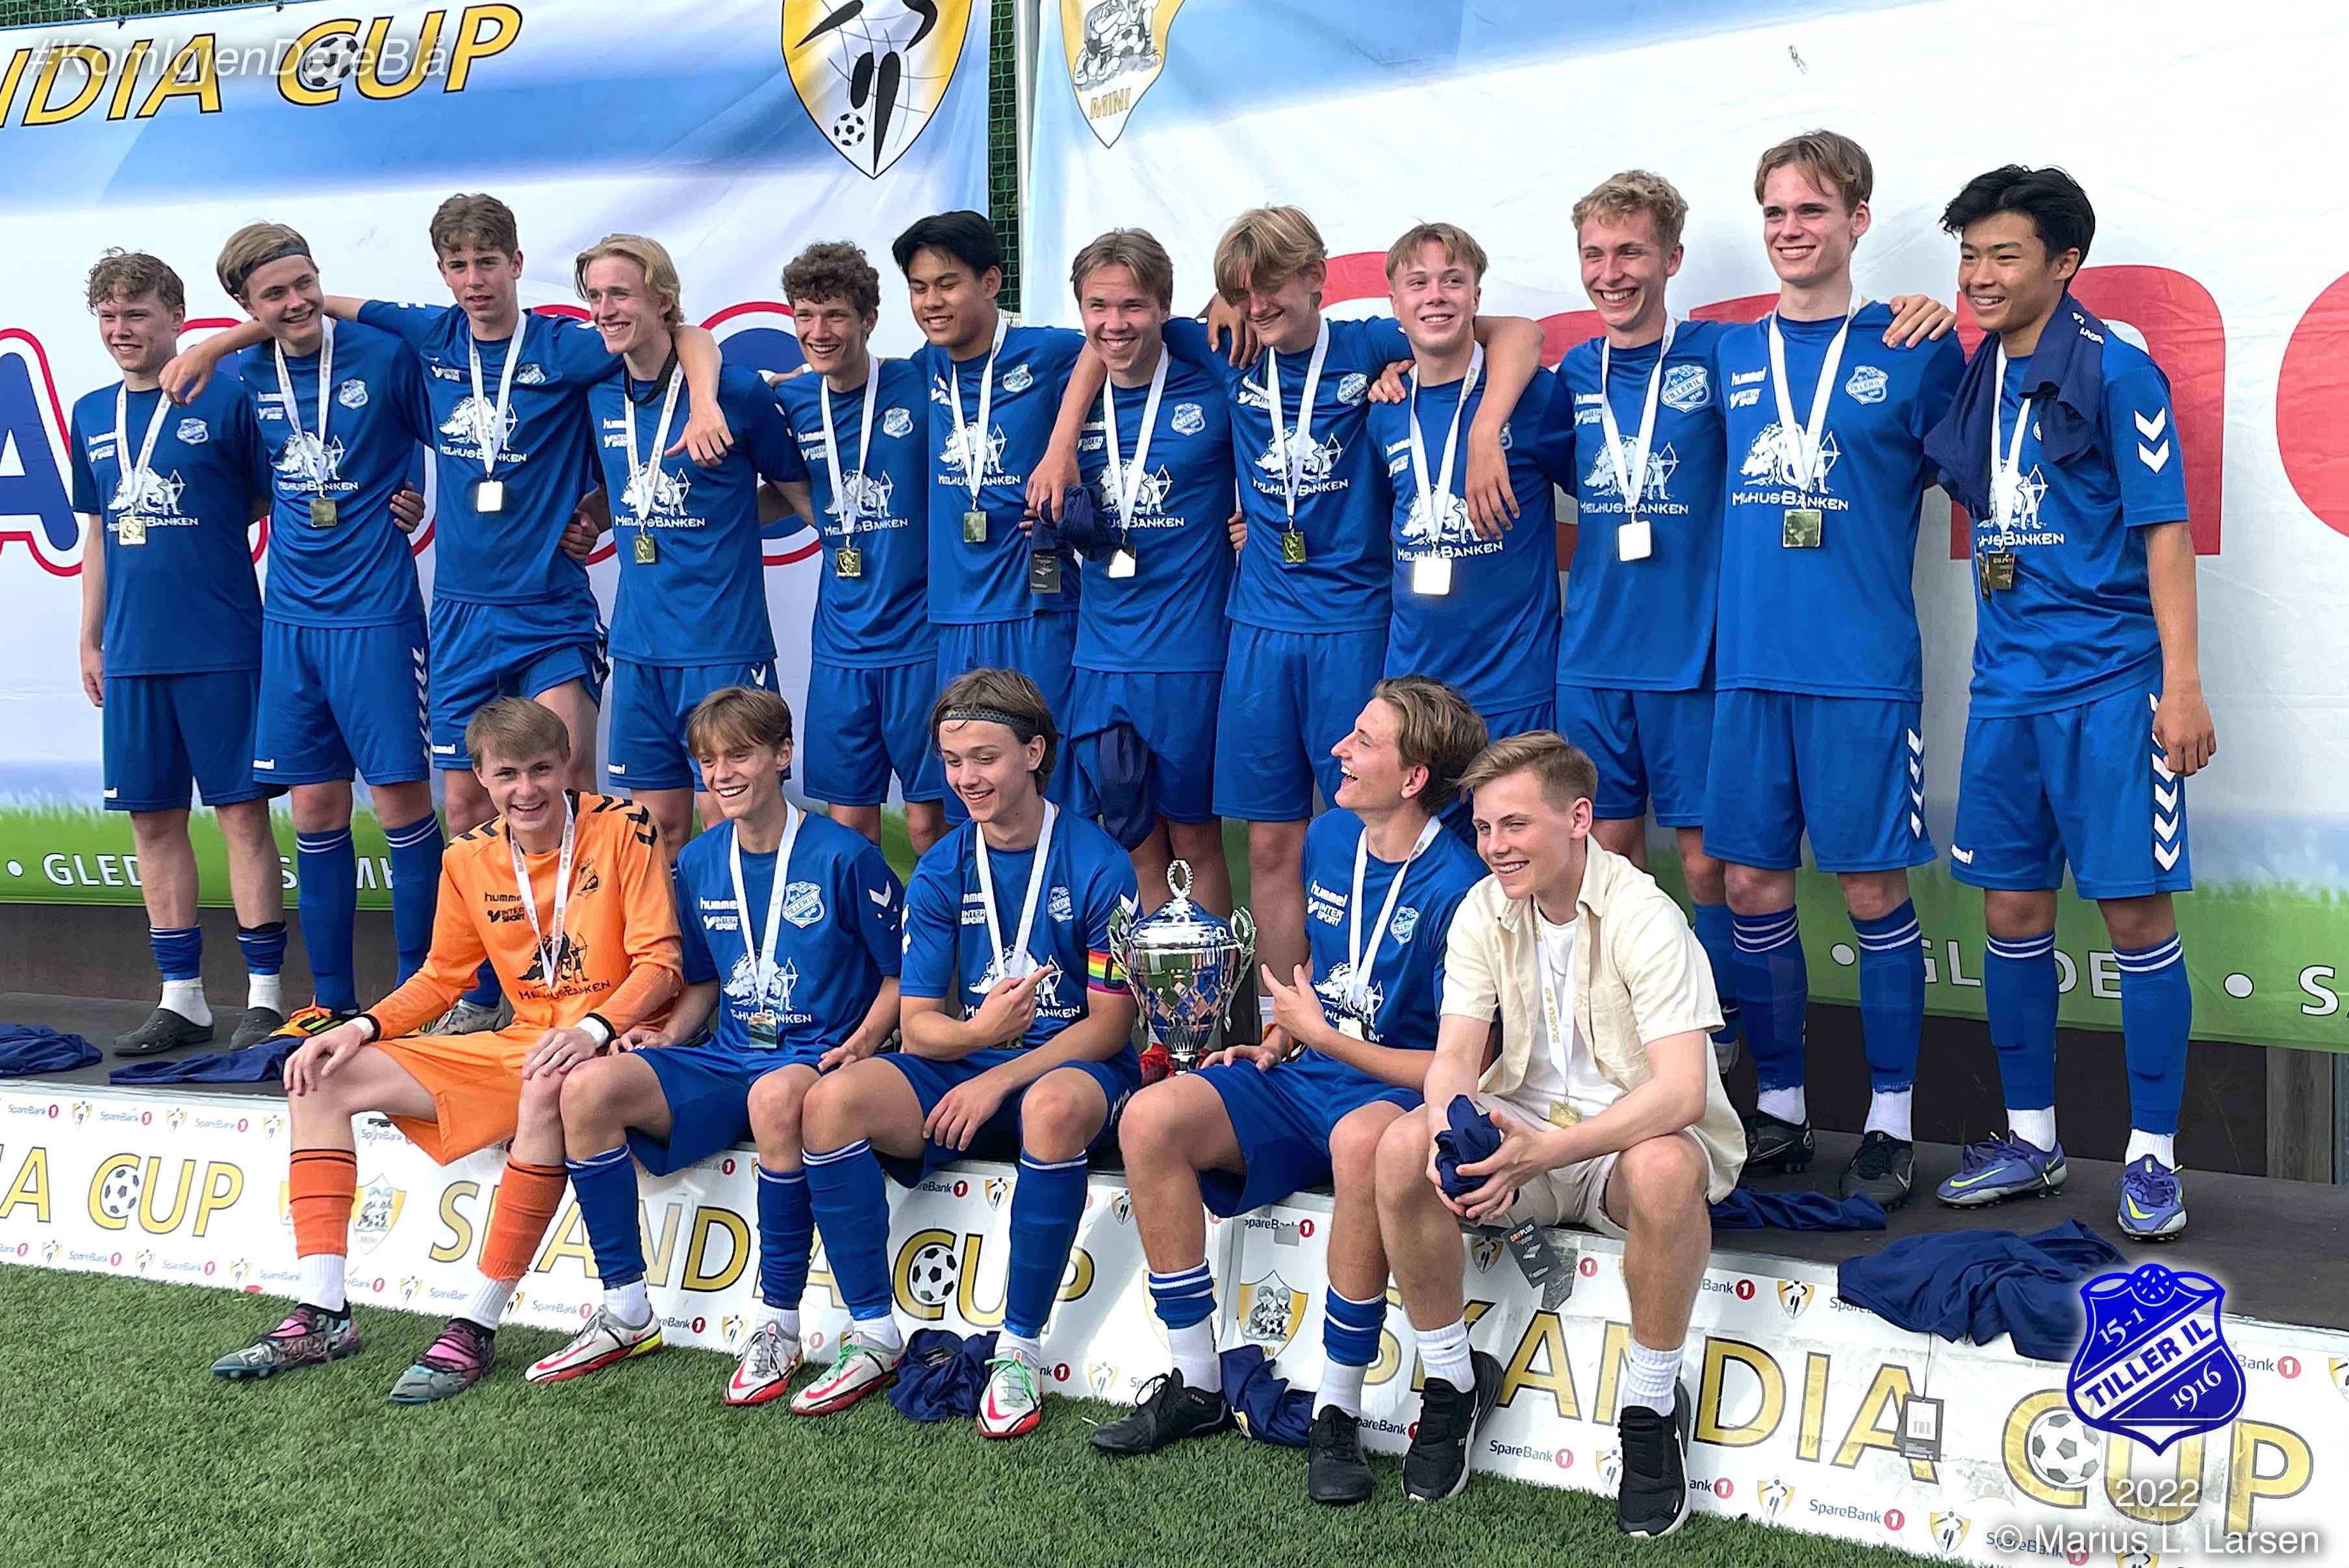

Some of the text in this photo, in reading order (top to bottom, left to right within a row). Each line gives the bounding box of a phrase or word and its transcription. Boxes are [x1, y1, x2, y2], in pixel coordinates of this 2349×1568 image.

[0, 3, 523, 127] DIA CUP
[1089, 88, 1131, 120] MINI
[43, 854, 141, 887] GLE
[485, 892, 522, 902] humme
[700, 897, 738, 910] humme
[961, 909, 985, 918] INTER
[2298, 965, 2349, 1017] S
[0, 1144, 244, 1237] A CUP
[1489, 1439, 1553, 1463] SpareBank
[1809, 1498, 1881, 1524] SpareBank
